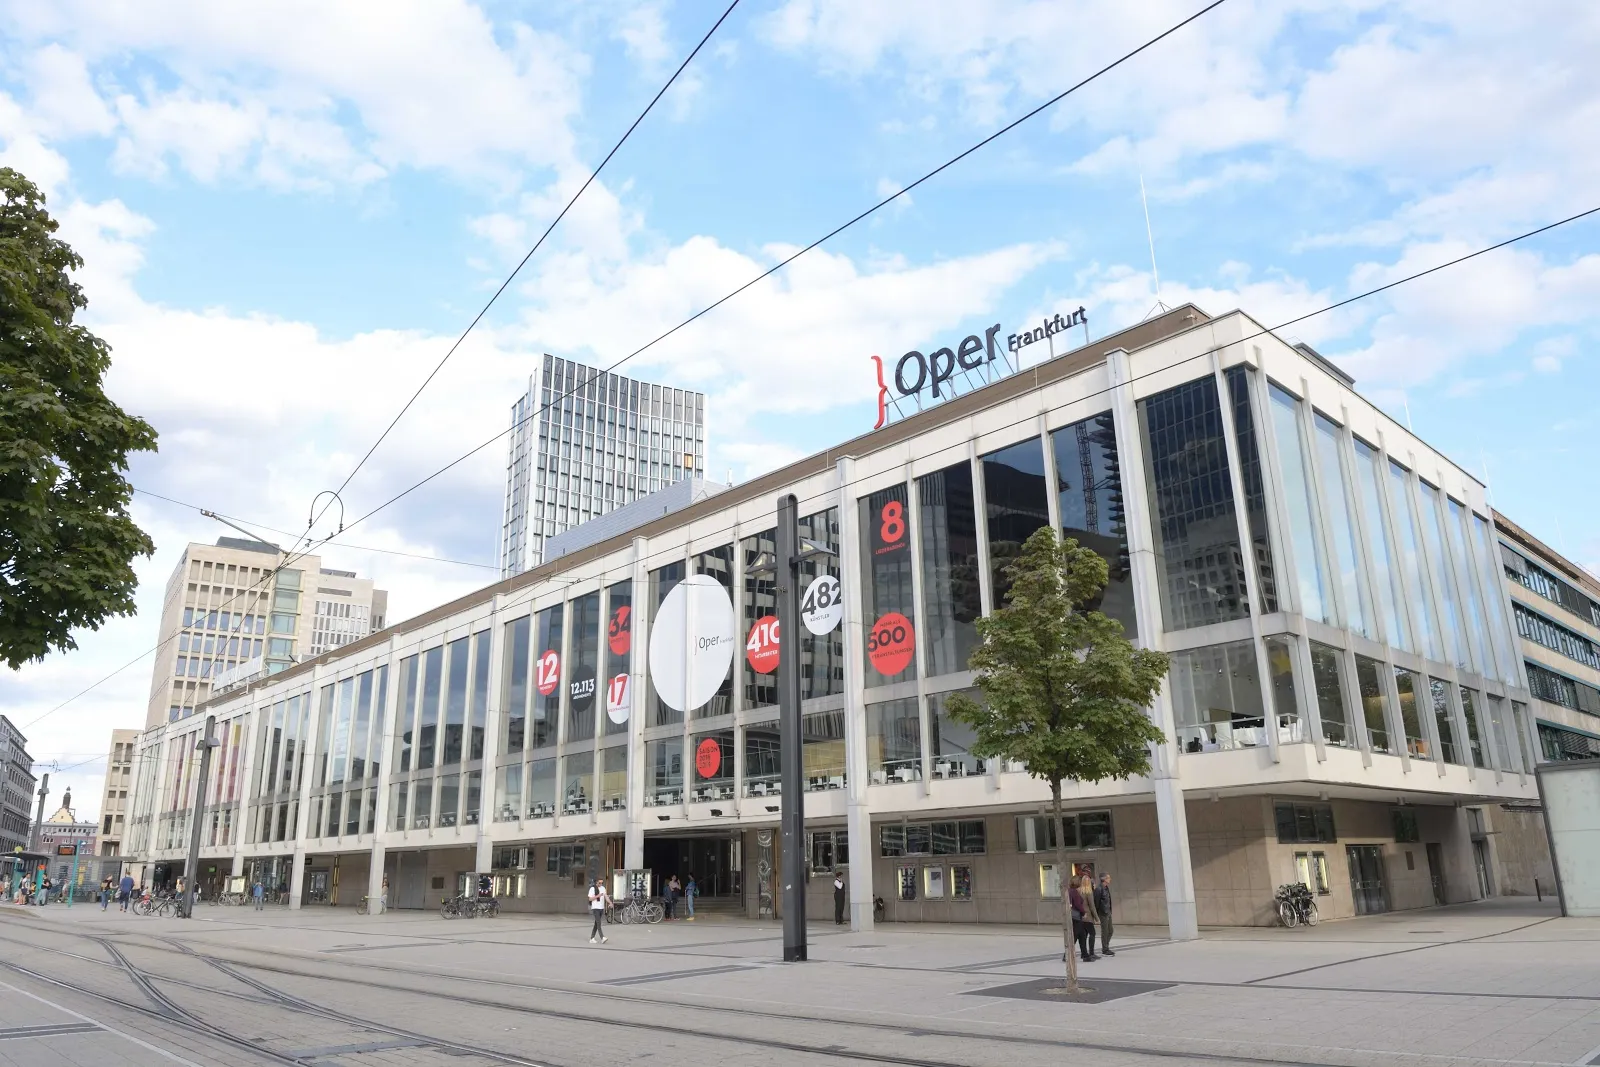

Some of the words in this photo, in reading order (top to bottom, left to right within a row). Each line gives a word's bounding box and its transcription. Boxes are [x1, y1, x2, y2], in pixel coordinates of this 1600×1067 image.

[895, 323, 1000, 398] Oper
[1007, 306, 1086, 352] Frankfurt
[881, 501, 905, 543] 8
[801, 582, 841, 615] 482
[699, 635, 719, 651] Oper
[867, 626, 906, 652] 500
[537, 653, 558, 686] 12
[571, 678, 595, 694] 12.113
[608, 675, 628, 705] 17
